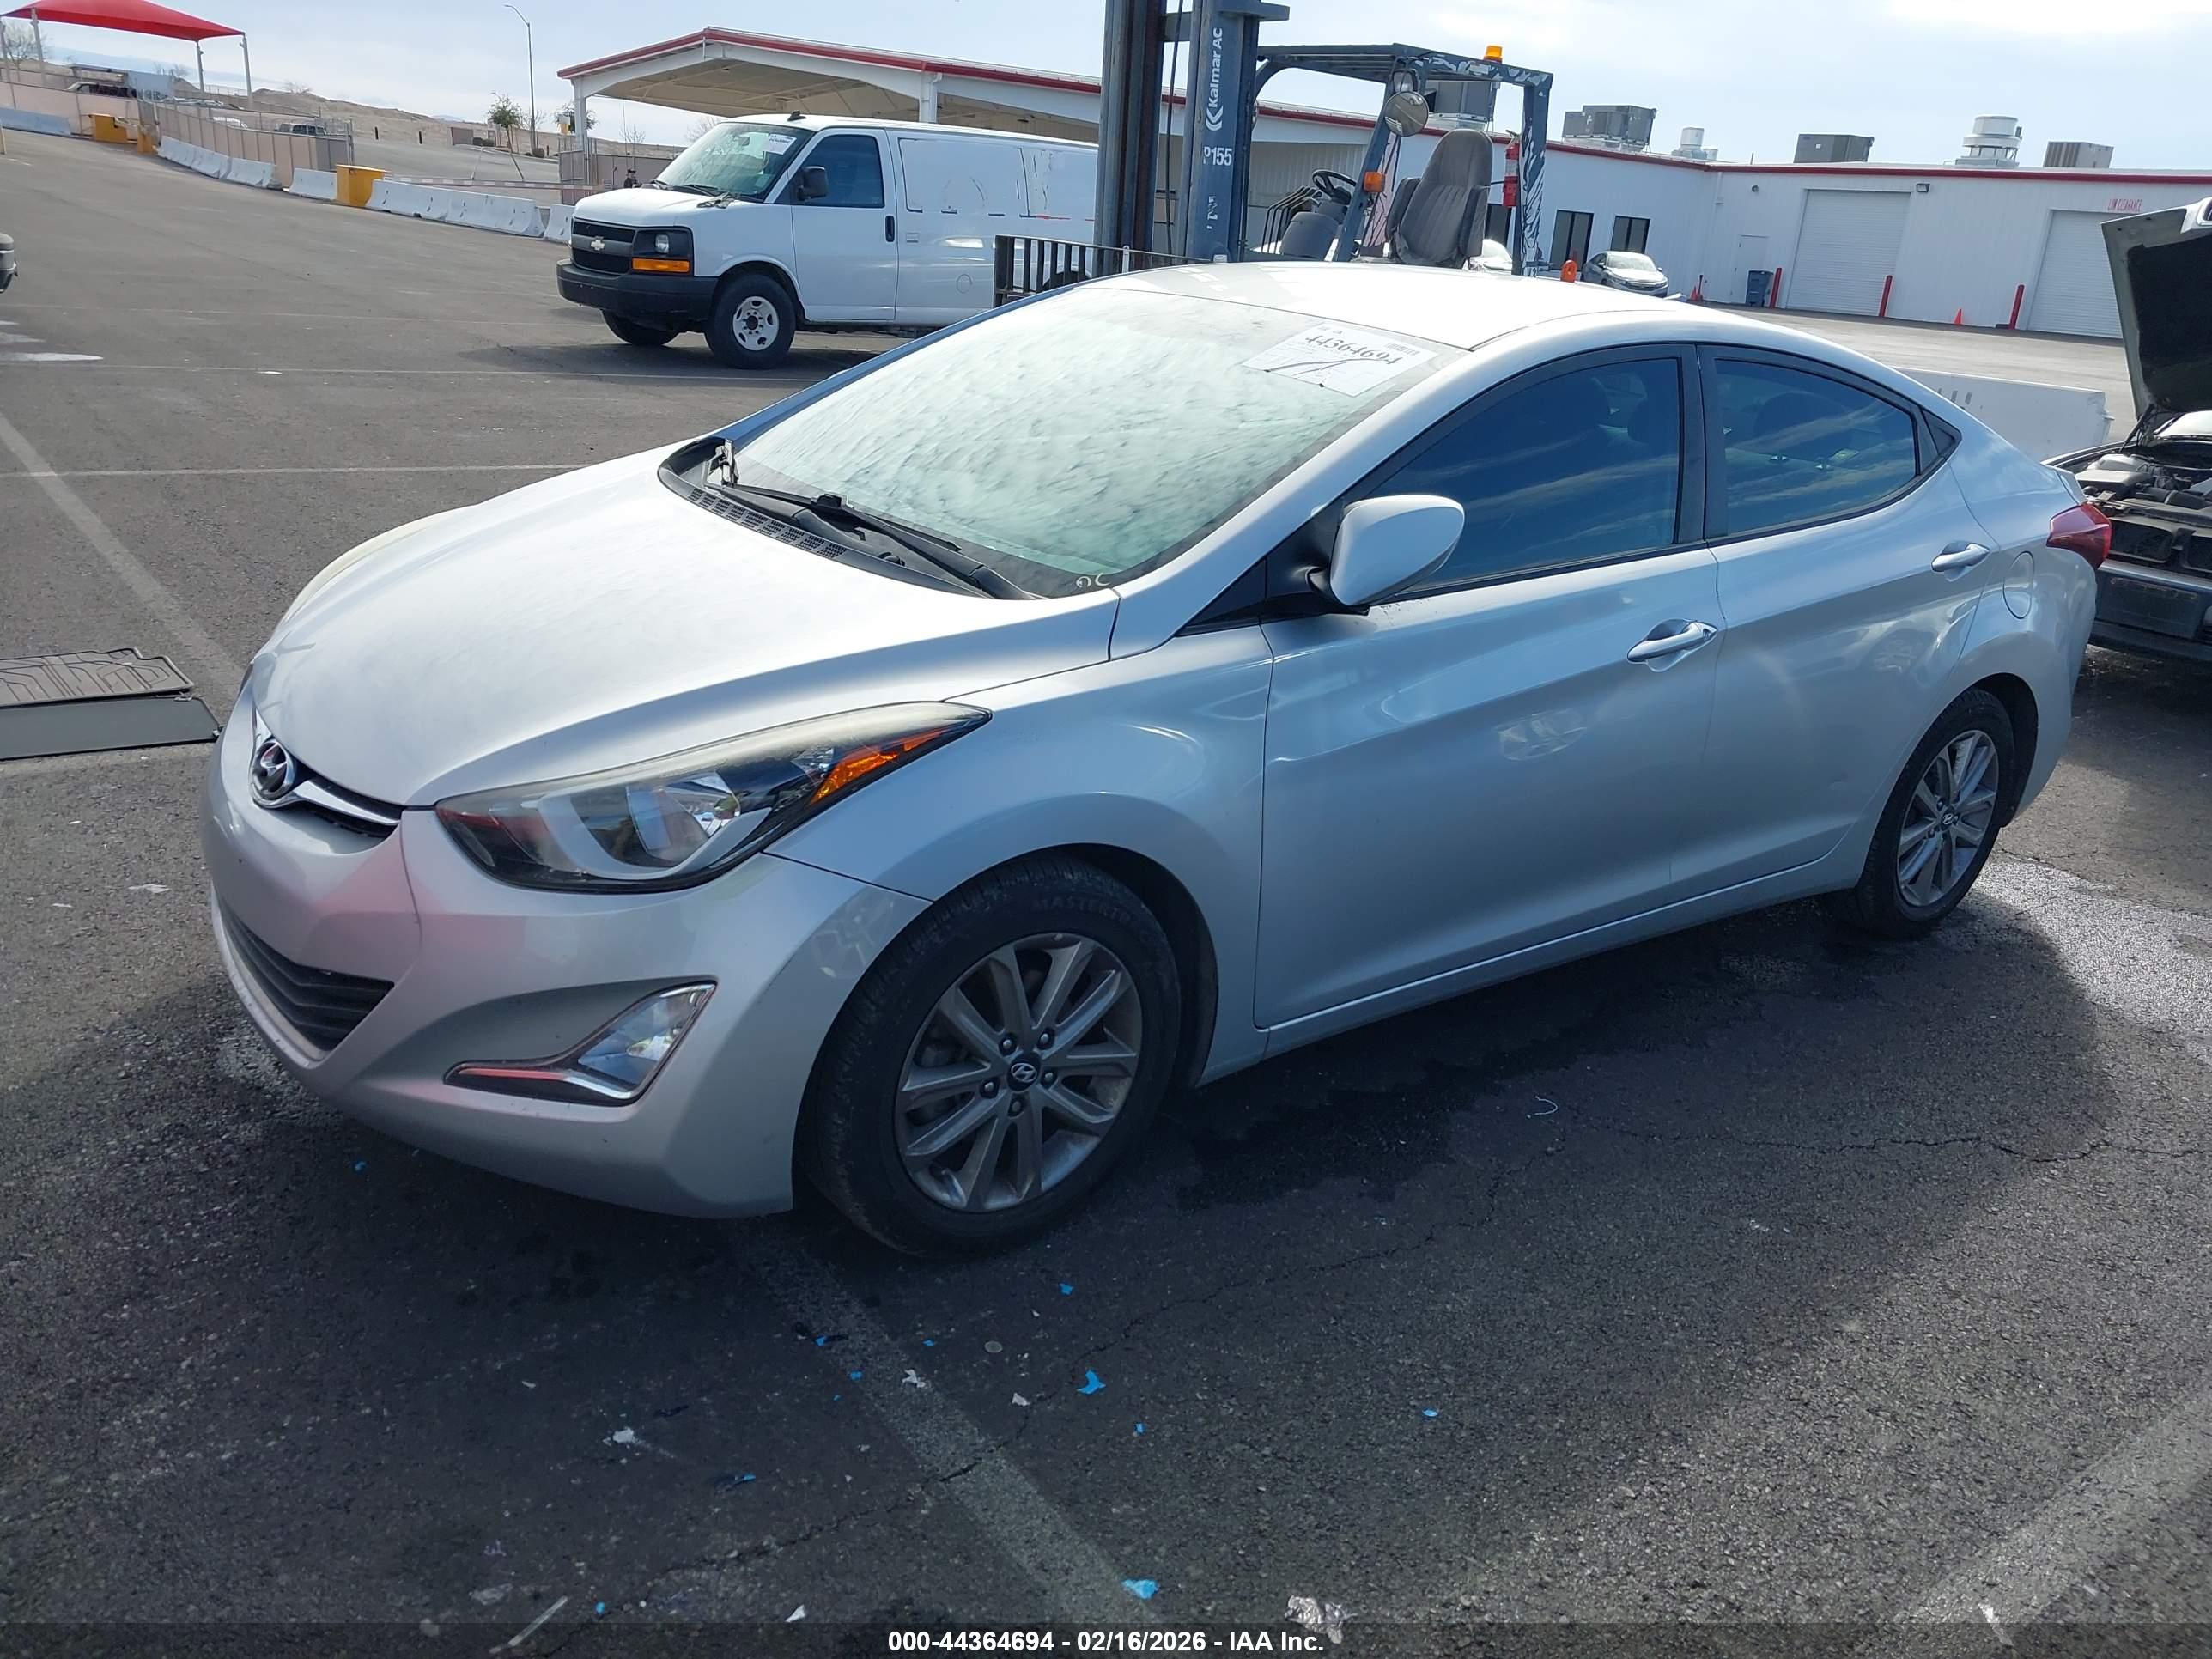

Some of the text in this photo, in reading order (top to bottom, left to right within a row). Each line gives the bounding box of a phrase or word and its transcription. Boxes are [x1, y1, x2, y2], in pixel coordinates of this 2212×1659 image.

[1208, 27, 1223, 108] Kalmar AC
[1203, 146, 1233, 166] P155
[1304, 334, 1403, 365] 44364694
